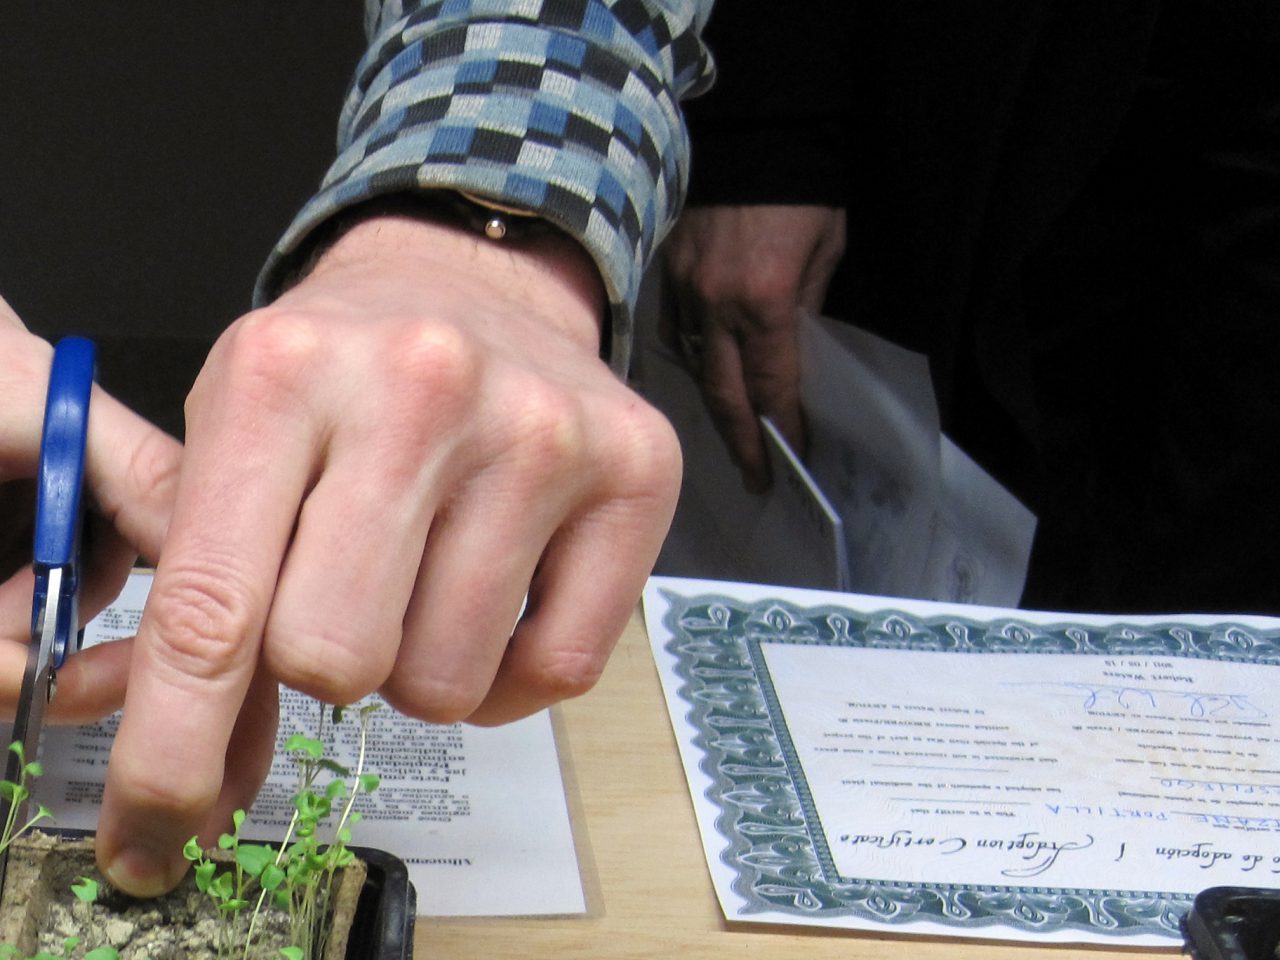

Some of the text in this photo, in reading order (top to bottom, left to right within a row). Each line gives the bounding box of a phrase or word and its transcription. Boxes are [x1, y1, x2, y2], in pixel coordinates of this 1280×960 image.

[838, 829, 967, 855] Certificate
[975, 831, 1093, 877] Adoption
[1154, 842, 1232, 869] adopción
[1240, 854, 1263, 872] de
